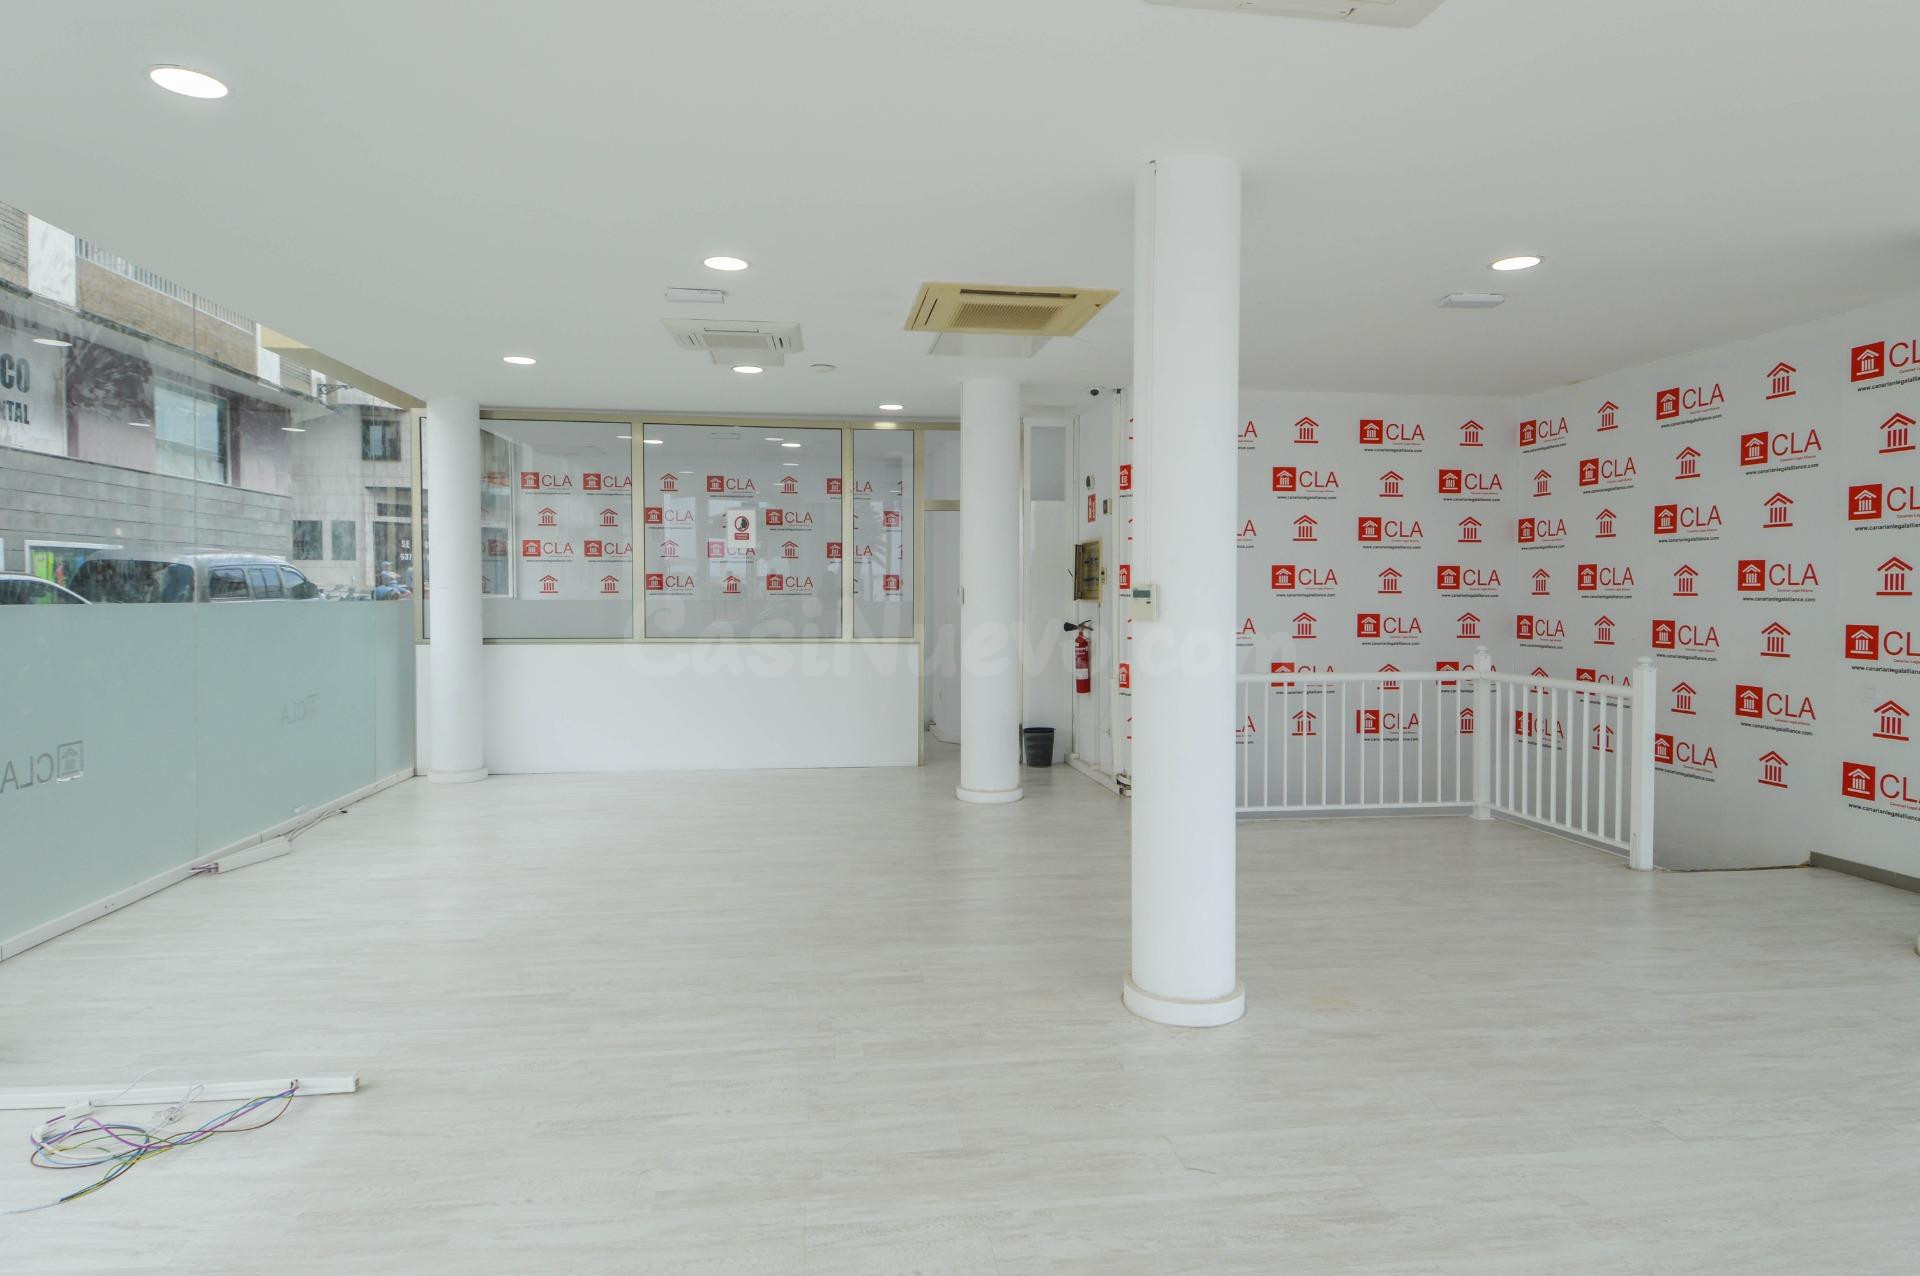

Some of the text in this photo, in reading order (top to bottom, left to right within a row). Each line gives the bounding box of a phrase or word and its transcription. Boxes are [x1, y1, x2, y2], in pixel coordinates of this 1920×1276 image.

[1889, 340, 1920, 367] CL
[1682, 384, 1724, 409] CLA
[1385, 424, 1424, 441] CLA
[1539, 417, 1568, 438] CLA
[1772, 429, 1821, 456] CLA
[1601, 457, 1636, 479] CLA
[542, 475, 572, 487] CLA
[603, 476, 632, 487] CLA
[726, 478, 755, 490] CLA
[855, 481, 872, 492] LA
[1299, 471, 1339, 488] CLA
[1465, 473, 1502, 490] CLA
[1887, 486, 1920, 511] CL
[664, 510, 693, 522] CLA
[784, 512, 813, 523] CLA
[1680, 505, 1722, 527] CLA
[1384, 521, 1423, 538] CLA
[1537, 519, 1566, 537] CLA
[543, 543, 573, 554] CLA
[604, 543, 633, 555] CLA
[855, 545, 872, 556] LA
[665, 576, 694, 588] CLA
[785, 577, 813, 588] CLA
[1298, 568, 1337, 586] CLA
[1463, 569, 1501, 586] CLA
[1600, 568, 1635, 586] CLA
[1769, 563, 1819, 585] CLA
[1383, 617, 1422, 634] CLA
[1535, 619, 1565, 637] CLA
[1678, 625, 1719, 648] CLA
[1884, 631, 1920, 656] CL
[1766, 693, 1816, 720] CLA
[1677, 742, 1718, 768] CLA
[1880, 775, 1920, 803] CL
